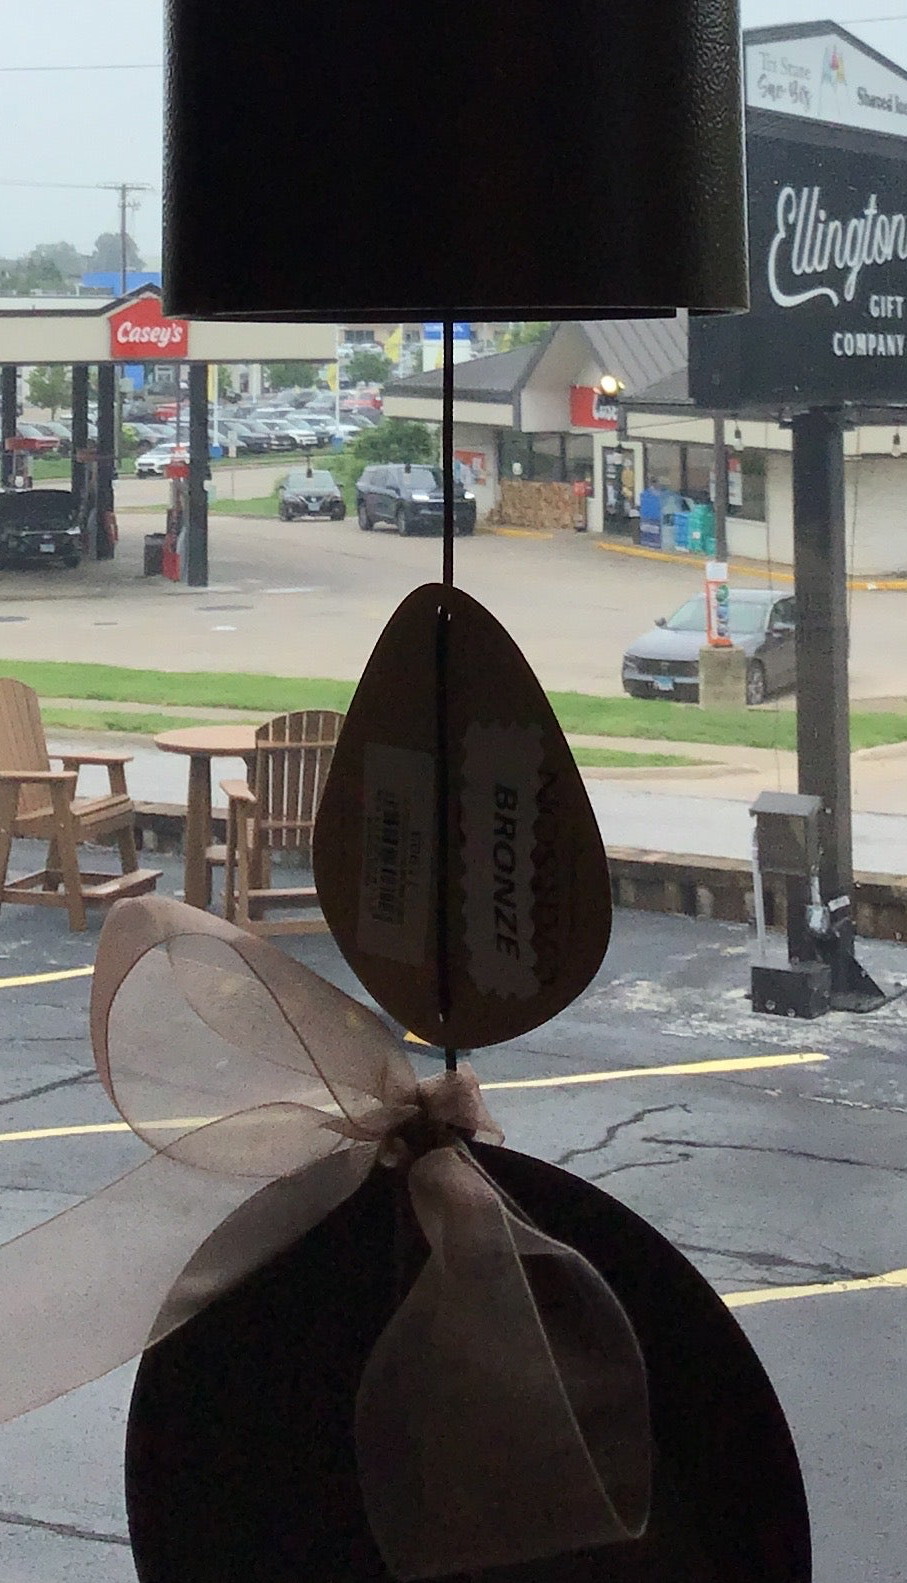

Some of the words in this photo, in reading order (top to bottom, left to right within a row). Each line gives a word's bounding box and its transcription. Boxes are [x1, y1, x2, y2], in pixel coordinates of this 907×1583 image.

[768, 186, 907, 307] Ellington
[869, 295, 904, 318] GIFT
[118, 321, 183, 347] Casey's
[833, 332, 905, 357] COMPANY
[493, 782, 521, 962] BRONZE
